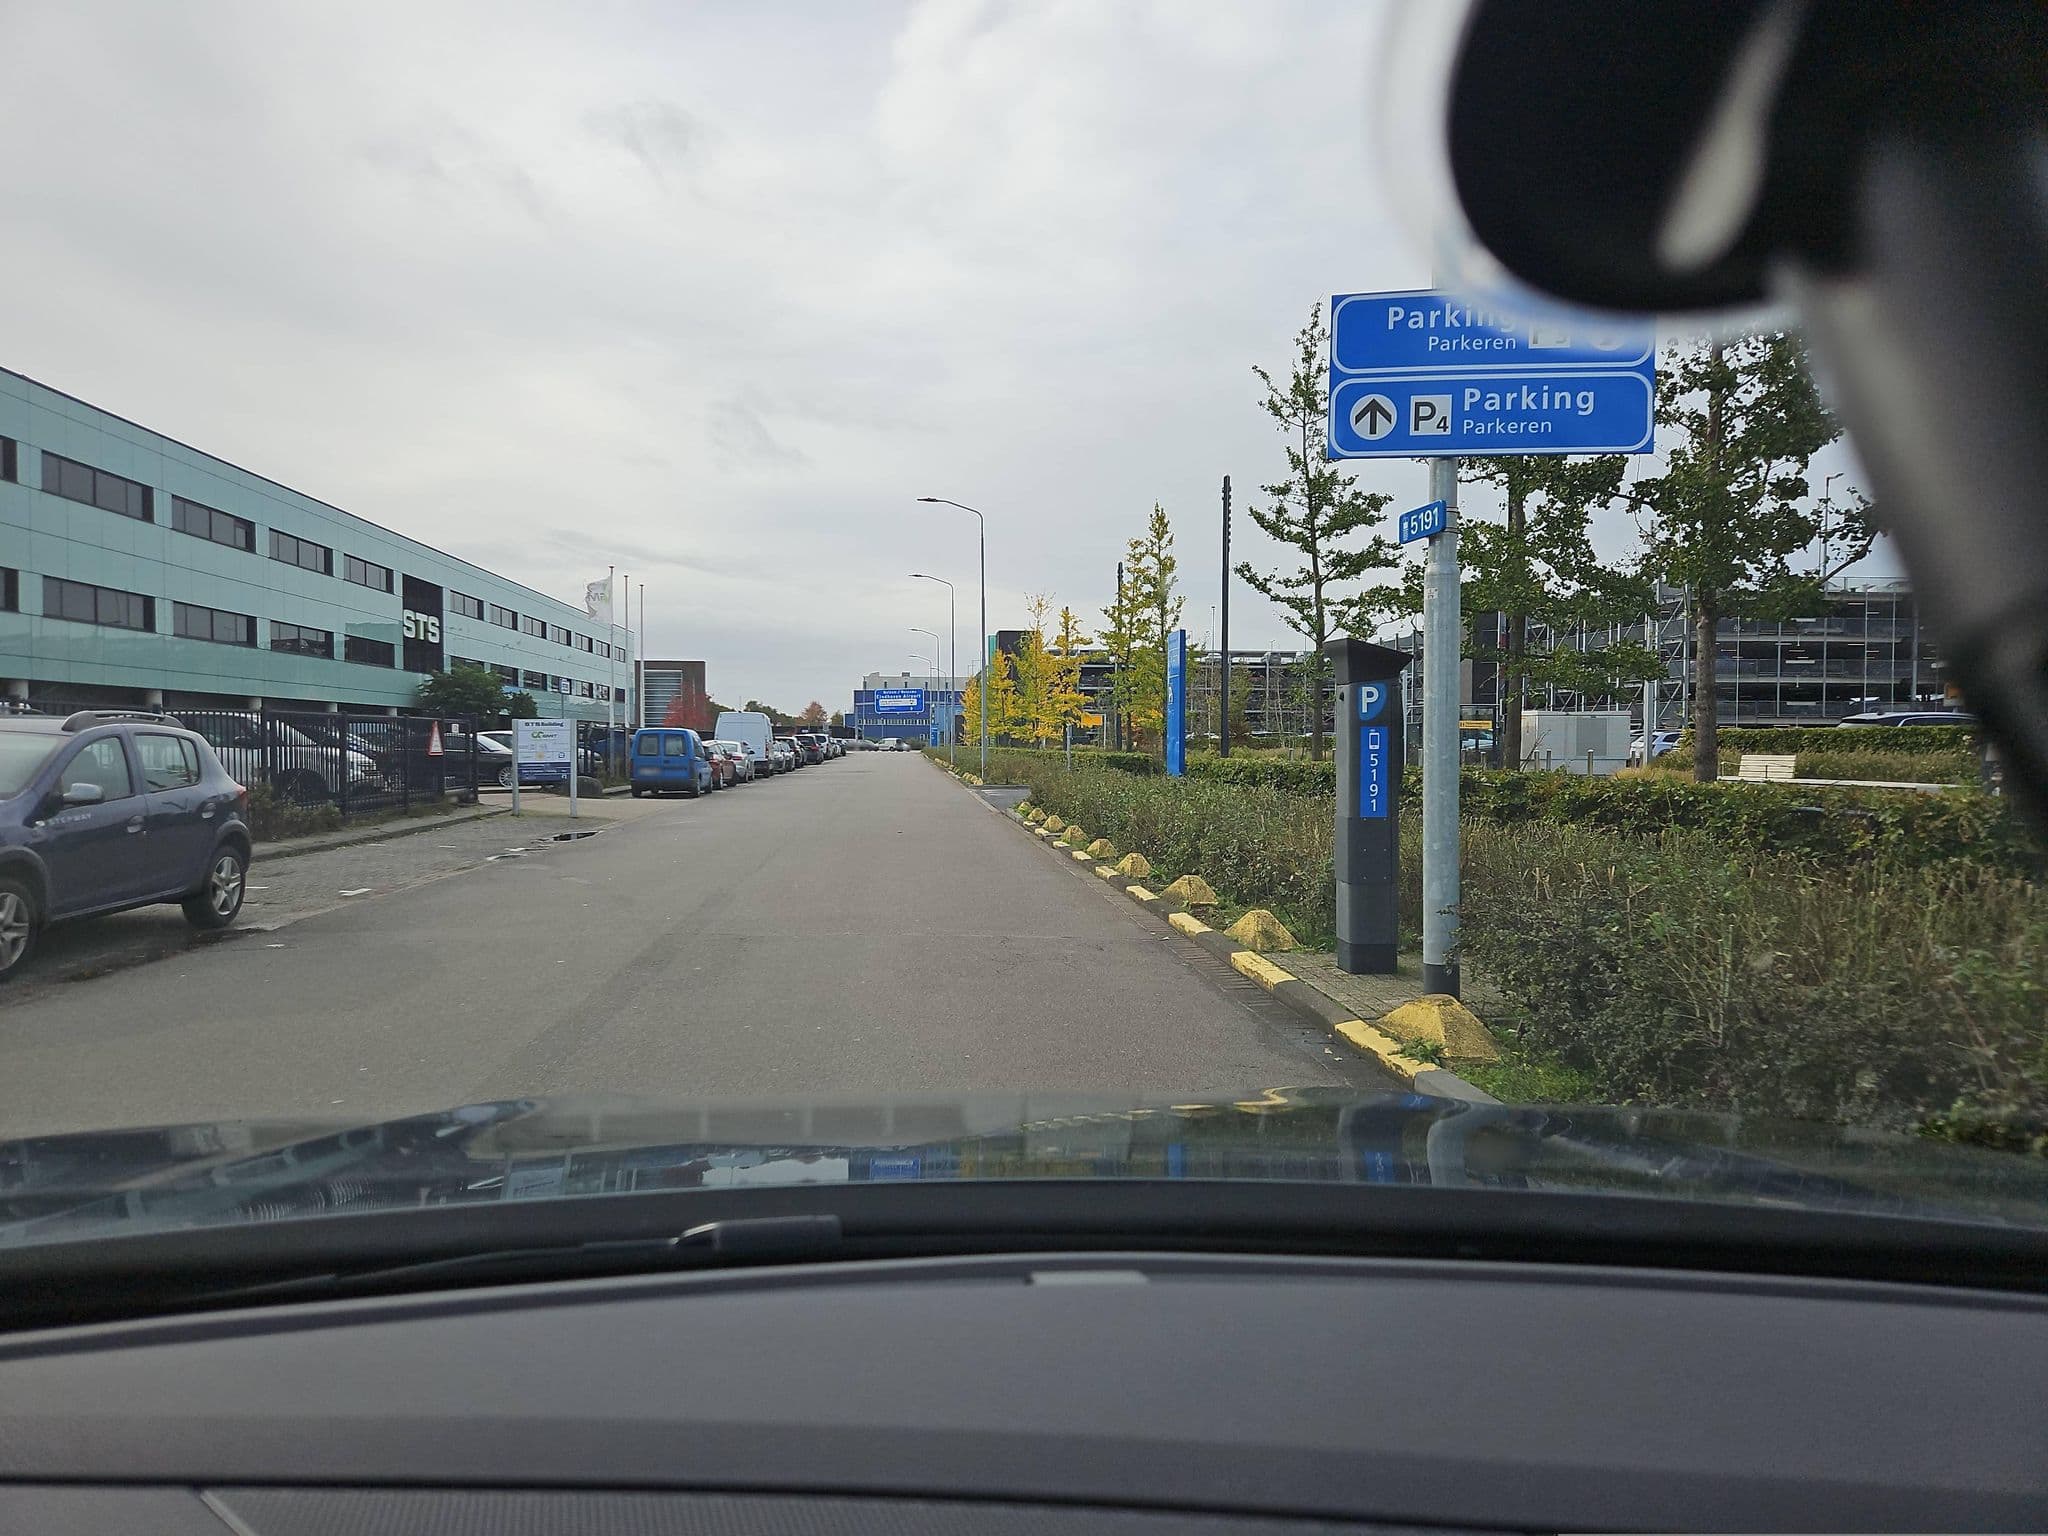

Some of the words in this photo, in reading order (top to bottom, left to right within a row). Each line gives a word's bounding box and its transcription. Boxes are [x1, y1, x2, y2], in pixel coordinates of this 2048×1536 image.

[1428, 335, 1516, 352] Parkeren
[1463, 385, 1595, 416] Parking
[1463, 417, 1552, 435] Parkeren
[1410, 507, 1439, 535] 5191
[403, 609, 440, 644] STS
[1361, 686, 1379, 713] P
[1369, 753, 1379, 812] 5191
